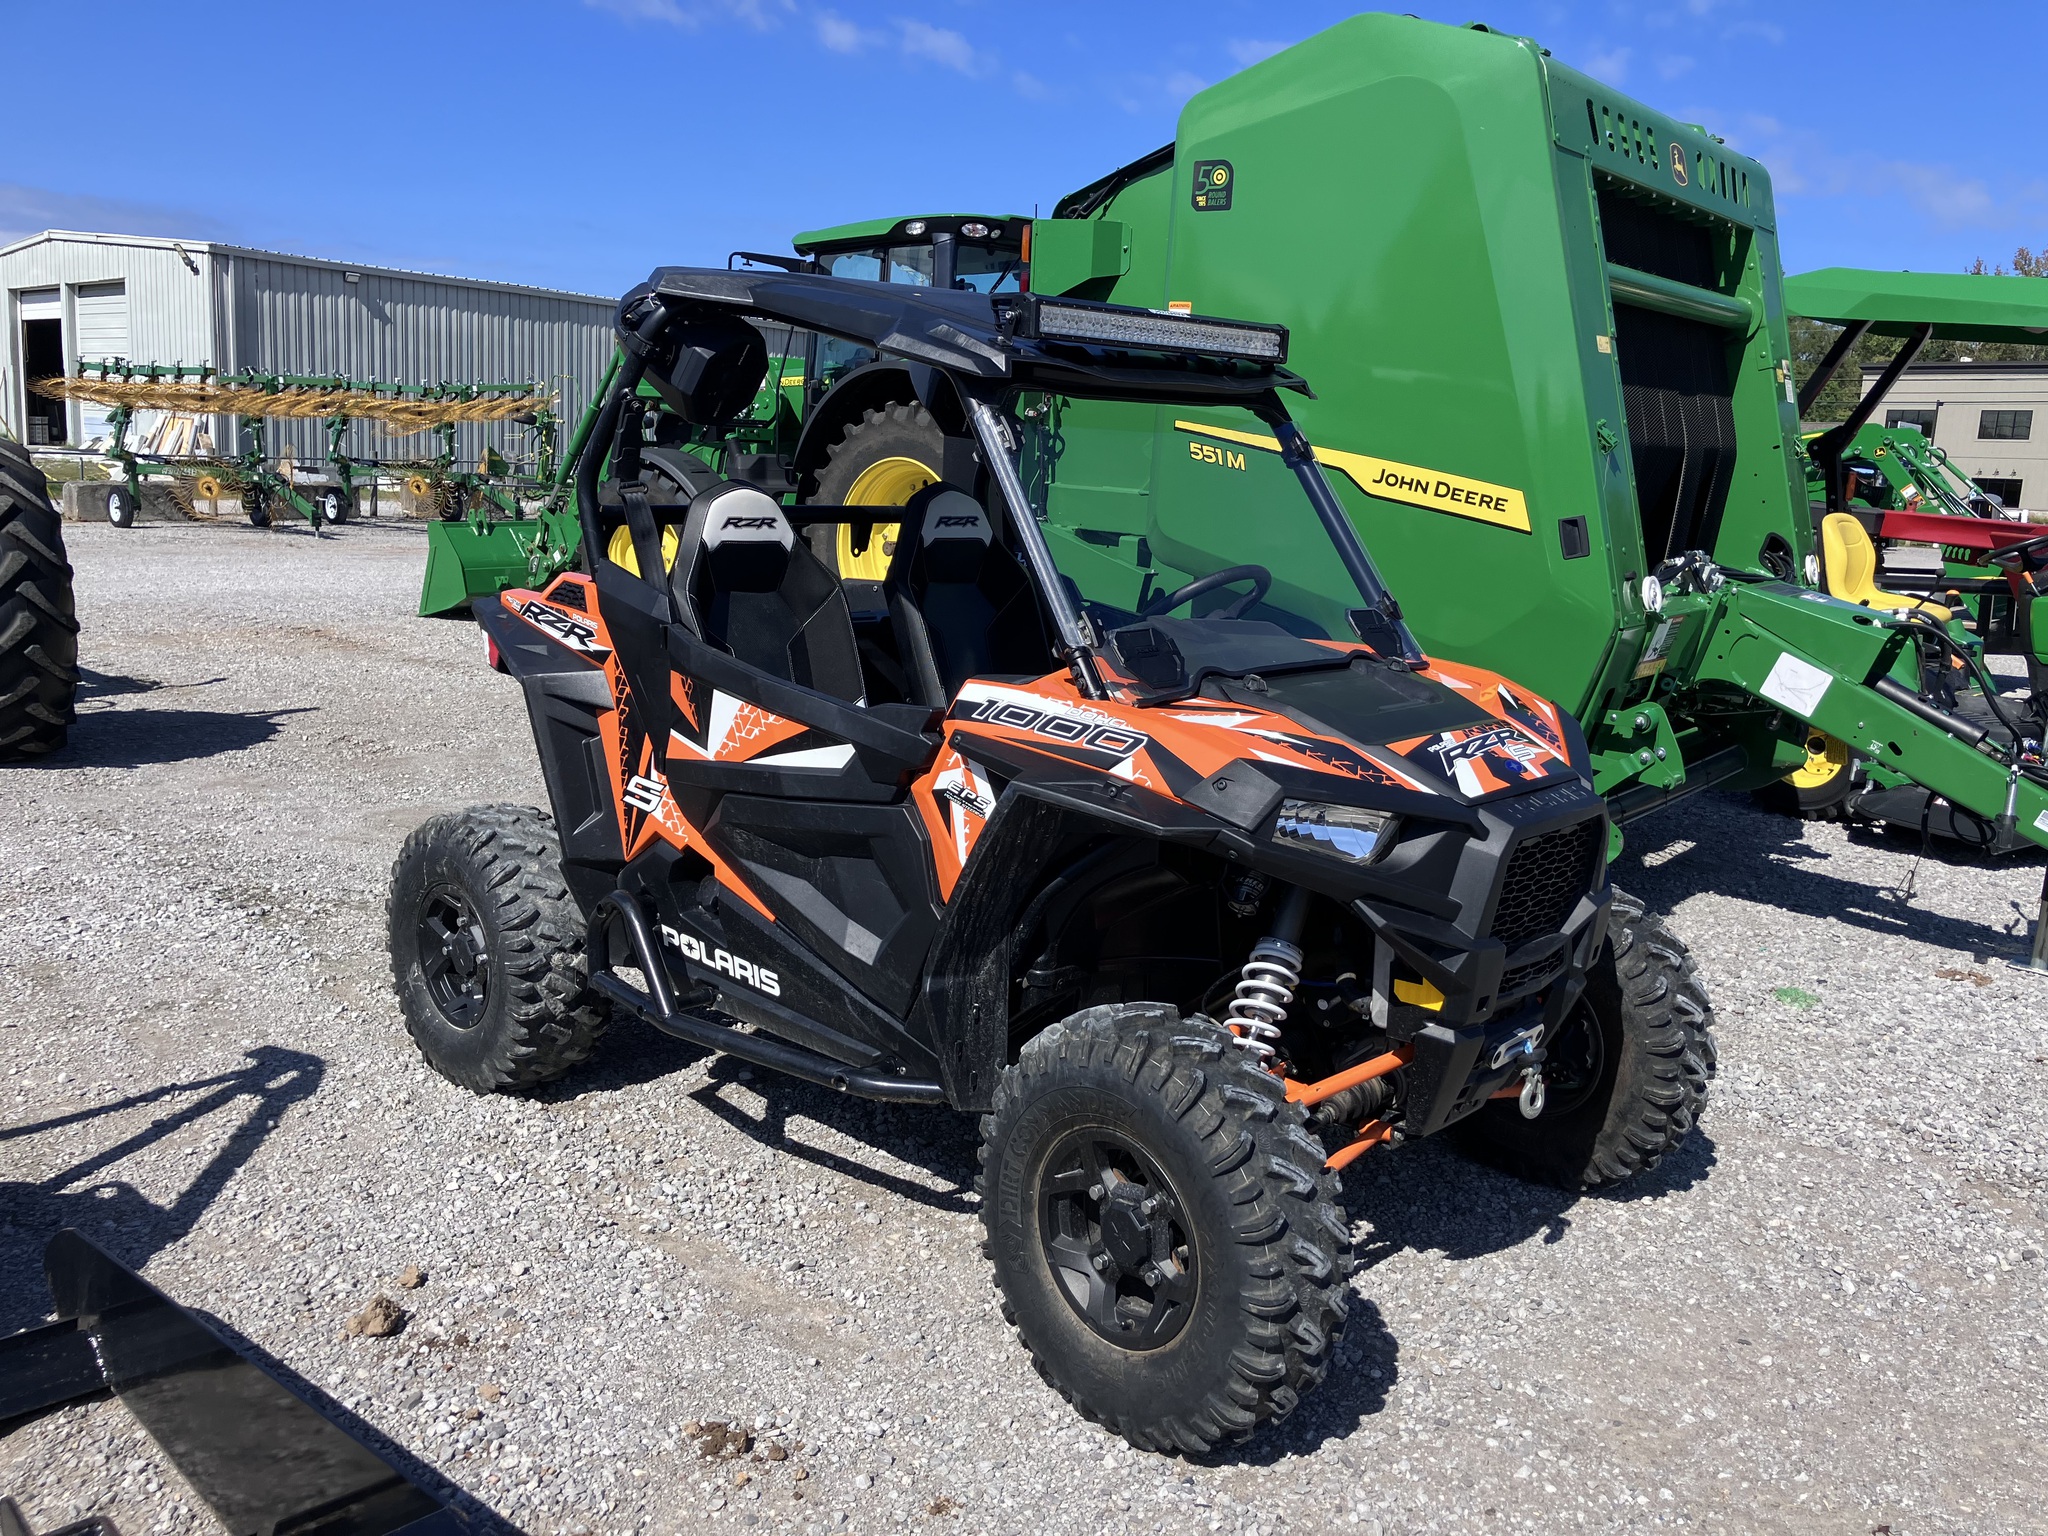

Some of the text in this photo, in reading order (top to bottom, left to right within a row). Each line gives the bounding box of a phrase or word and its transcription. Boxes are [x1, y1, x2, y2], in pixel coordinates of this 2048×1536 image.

[1195, 165, 1230, 195] 50
[1188, 441, 1246, 472] 551 M
[1372, 468, 1509, 513] JOHN DEERE
[720, 516, 778, 530] RZR
[934, 515, 980, 528] RZR
[520, 600, 597, 652] RZR
[572, 613, 598, 629] POLARIS
[971, 696, 1149, 758] 1000
[1439, 728, 1529, 777] RZR
[946, 780, 992, 811] EPS
[661, 923, 781, 997] POLARIS
